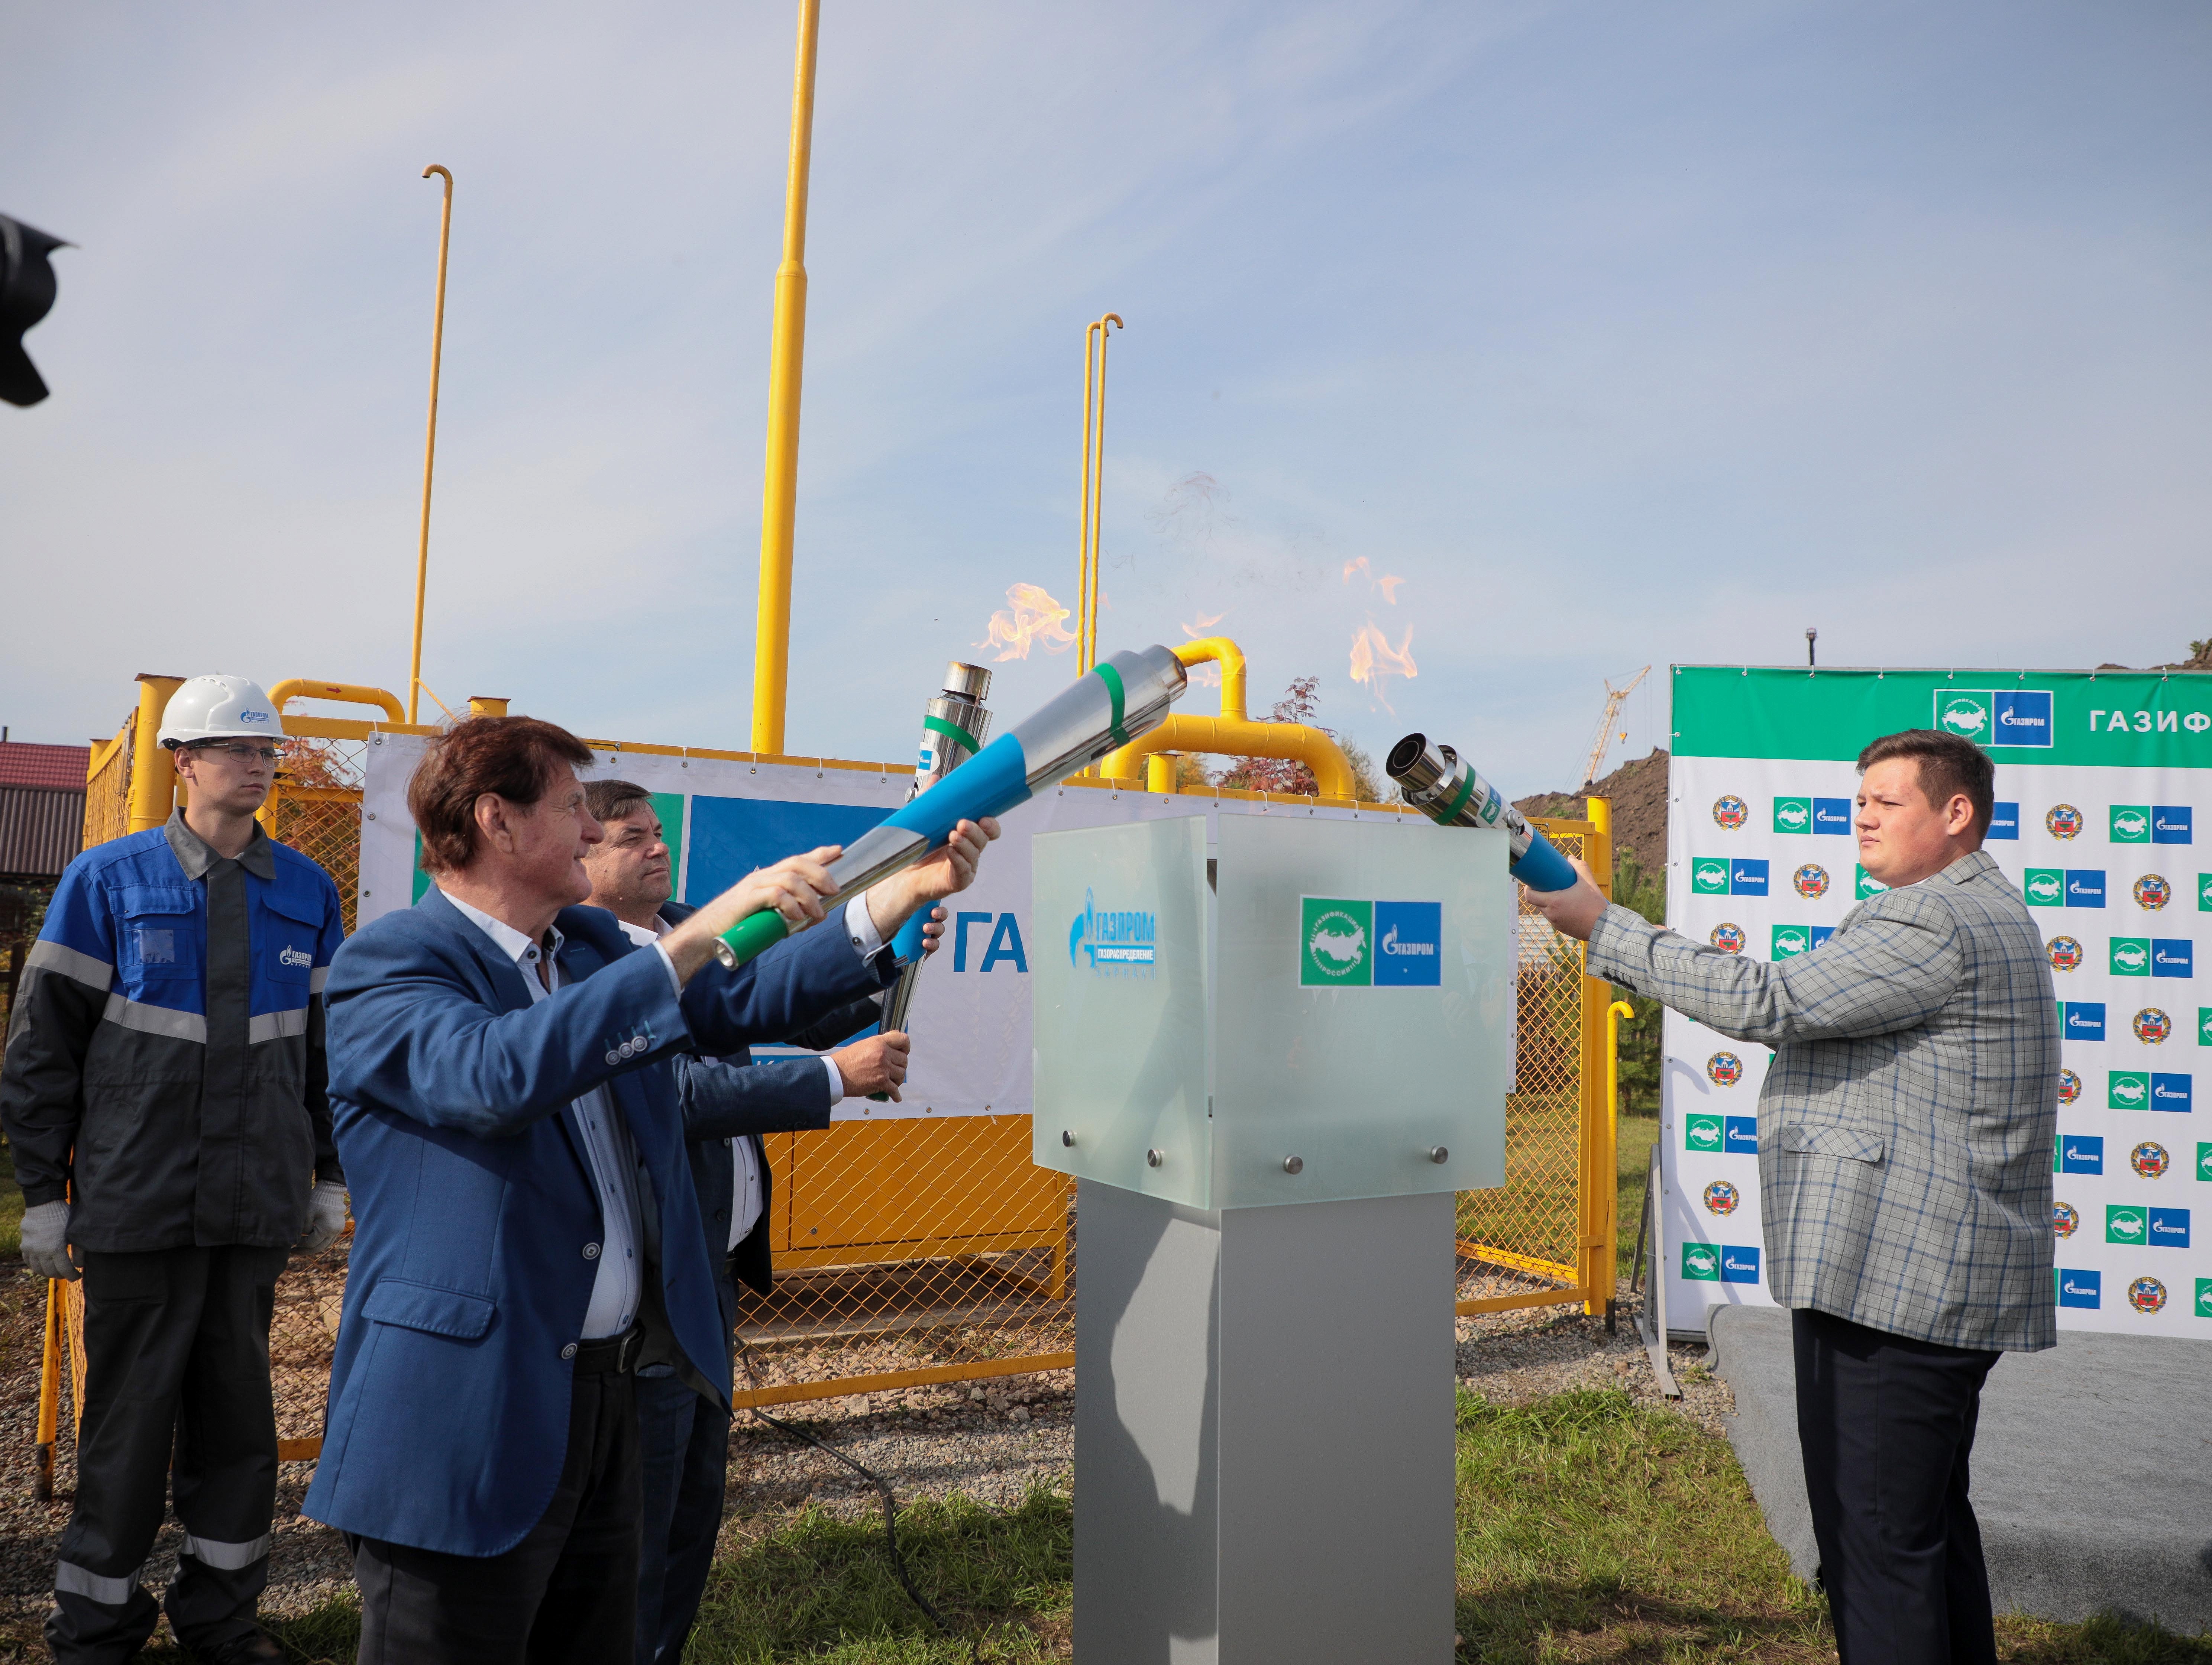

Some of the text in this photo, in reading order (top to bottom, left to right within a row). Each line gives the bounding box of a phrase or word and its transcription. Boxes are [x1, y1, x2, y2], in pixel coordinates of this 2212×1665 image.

[2013, 717, 2044, 726] ГАЗПРОМ
[2090, 710, 2211, 733] ГАЗИФ
[1097, 912, 1155, 943] ГАЗПРОМ
[1315, 911, 1359, 930] ГАЗИФИКАЦИЯ
[953, 912, 1028, 973] ГА
[1398, 943, 1434, 955] ГАЗПРОМ
[1098, 948, 1154, 961] ГАЗОРАСПРЕДЕЛЕНИЕ
[1096, 966, 1156, 980] БАРНАУЛ
[1323, 966, 1351, 976] РОССИИ
